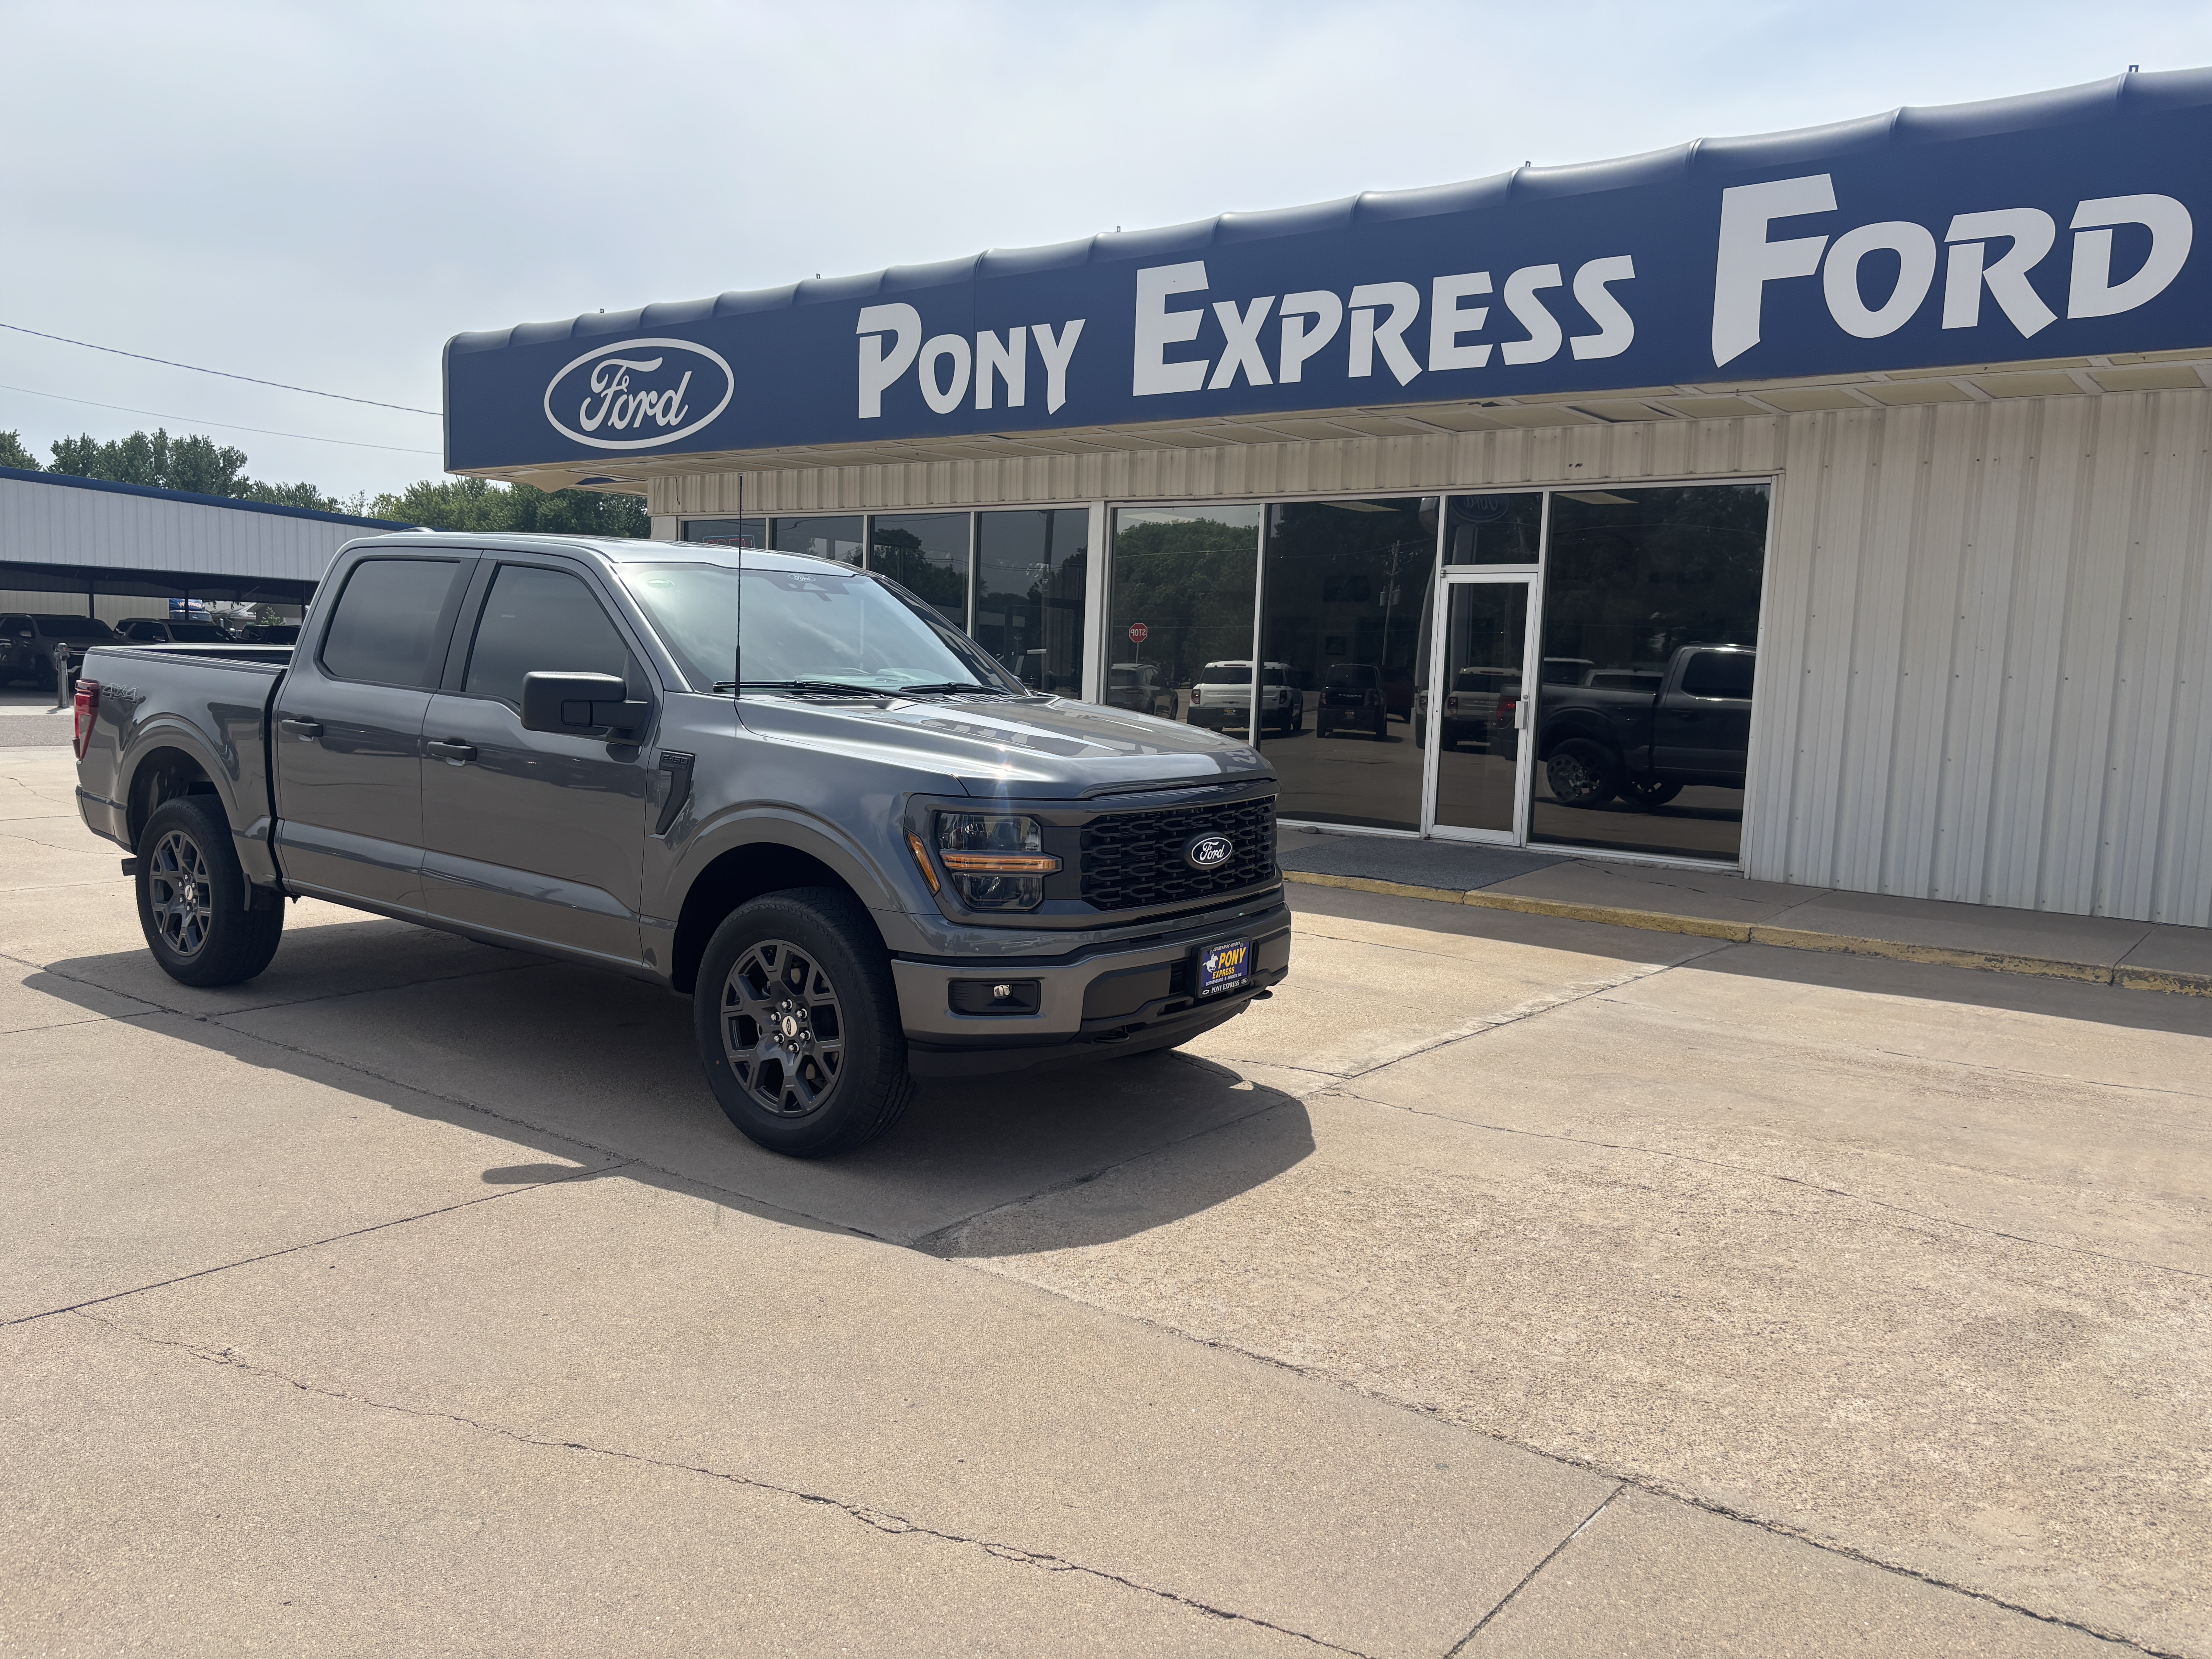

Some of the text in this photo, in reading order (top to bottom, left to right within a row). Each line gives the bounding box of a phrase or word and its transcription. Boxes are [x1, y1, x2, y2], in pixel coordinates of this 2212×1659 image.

[856, 173, 2193, 419] PONY EXPRESS FORD
[580, 357, 692, 431] Ford
[661, 754, 688, 764] F-150
[1200, 841, 1225, 861] Ford
[1218, 947, 1247, 969] PONY
[1212, 967, 1235, 979] EXPRESS
[1211, 985, 1223, 993] PONY
[1223, 980, 1240, 990] EXPRESS
